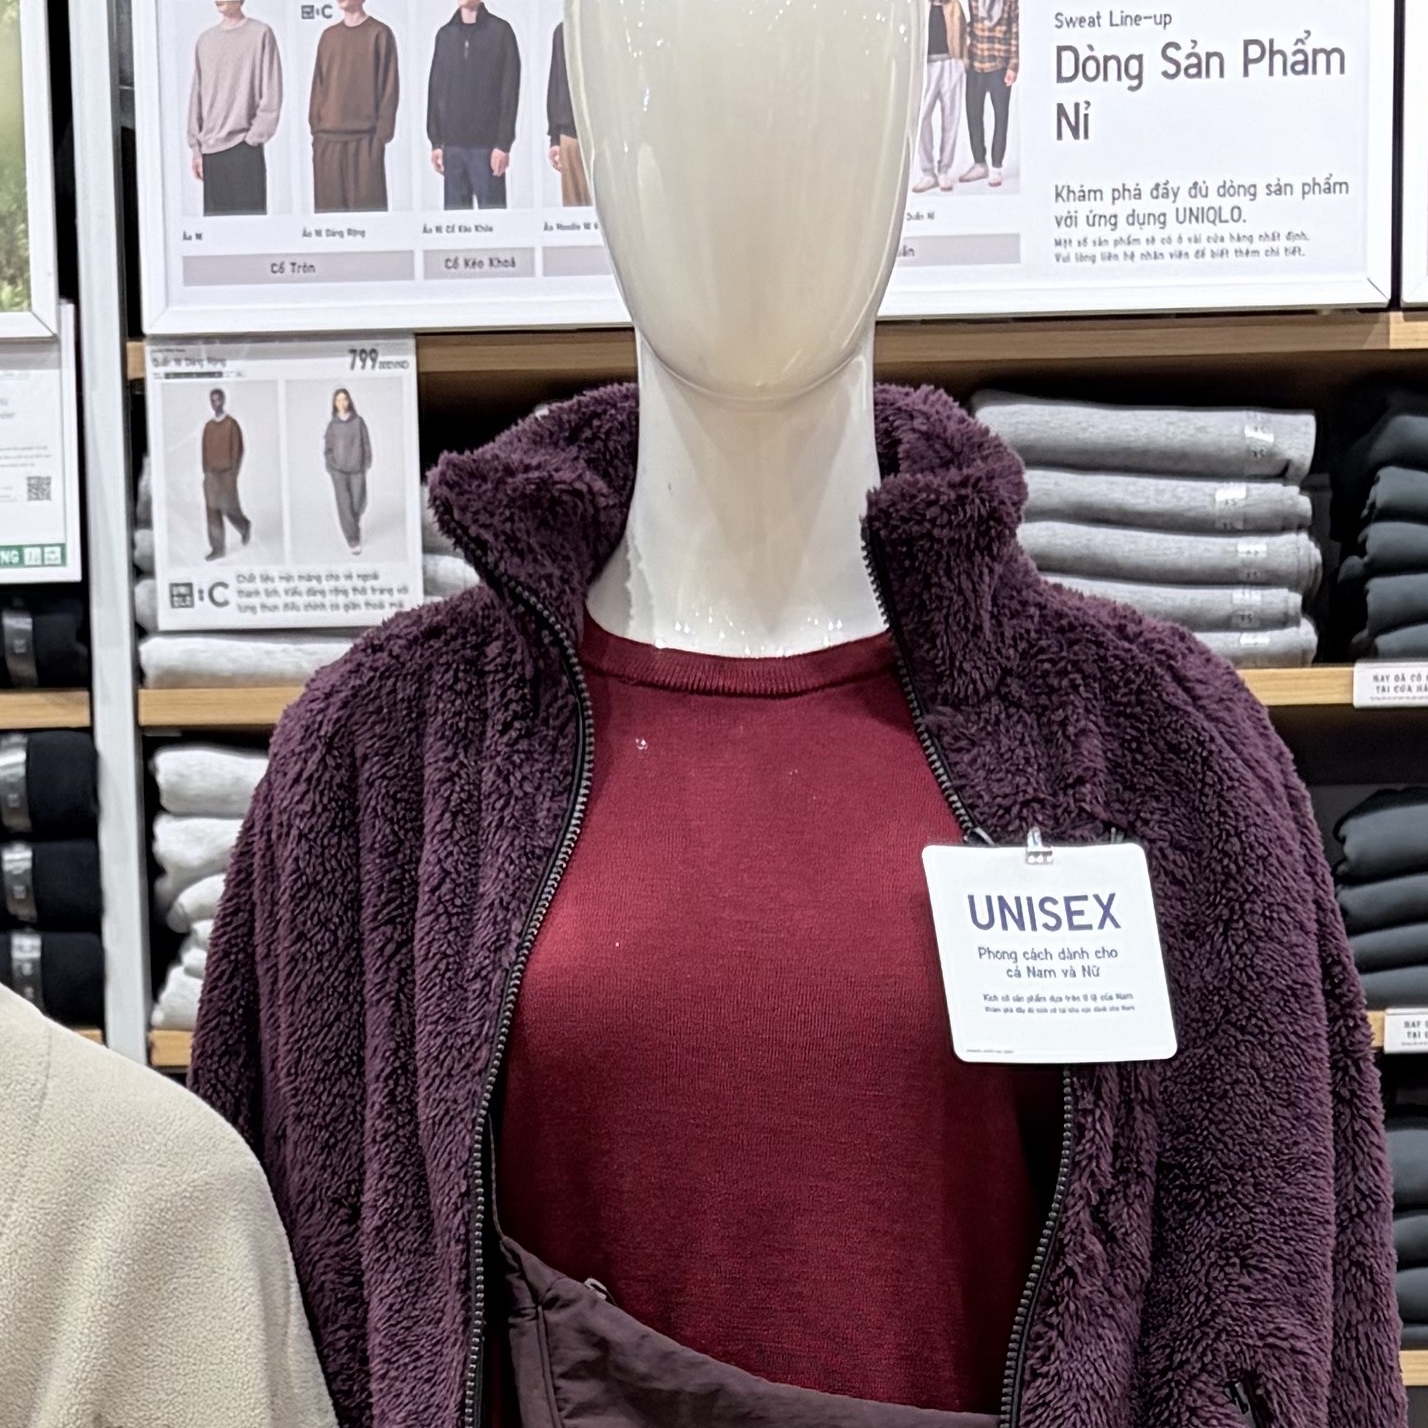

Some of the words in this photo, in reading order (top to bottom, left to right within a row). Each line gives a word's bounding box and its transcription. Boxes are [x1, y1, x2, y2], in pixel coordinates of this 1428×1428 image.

[1054, 10, 1102, 30] Sweat
[1109, 8, 1173, 32] Line-up
[1055, 43, 1145, 93] Dòng
[1160, 39, 1226, 81] Sản
[1242, 28, 1347, 79] Phẩm
[1056, 100, 1092, 141] Nỉ
[1054, 182, 1104, 204] Khám
[1111, 181, 1142, 206] phá
[1149, 178, 1181, 205] đầy
[1187, 179, 1209, 200] đủ
[1216, 178, 1258, 203] dòng
[1265, 177, 1294, 197] sản
[1301, 172, 1350, 200] phẩm
[1054, 208, 1079, 230] với
[1085, 208, 1120, 233] ứng
[1125, 207, 1168, 232] dụng
[1175, 205, 1247, 227] UNIQLO.
[967, 892, 1122, 932] UNISEX
[977, 946, 1018, 964] Phong
[1022, 946, 1053, 961] cách
[1057, 946, 1090, 961] dành
[1094, 946, 1119, 960] cho
[1026, 965, 1057, 979] Nam
[1061, 965, 1077, 979] và
[1081, 964, 1101, 978] Nữ
